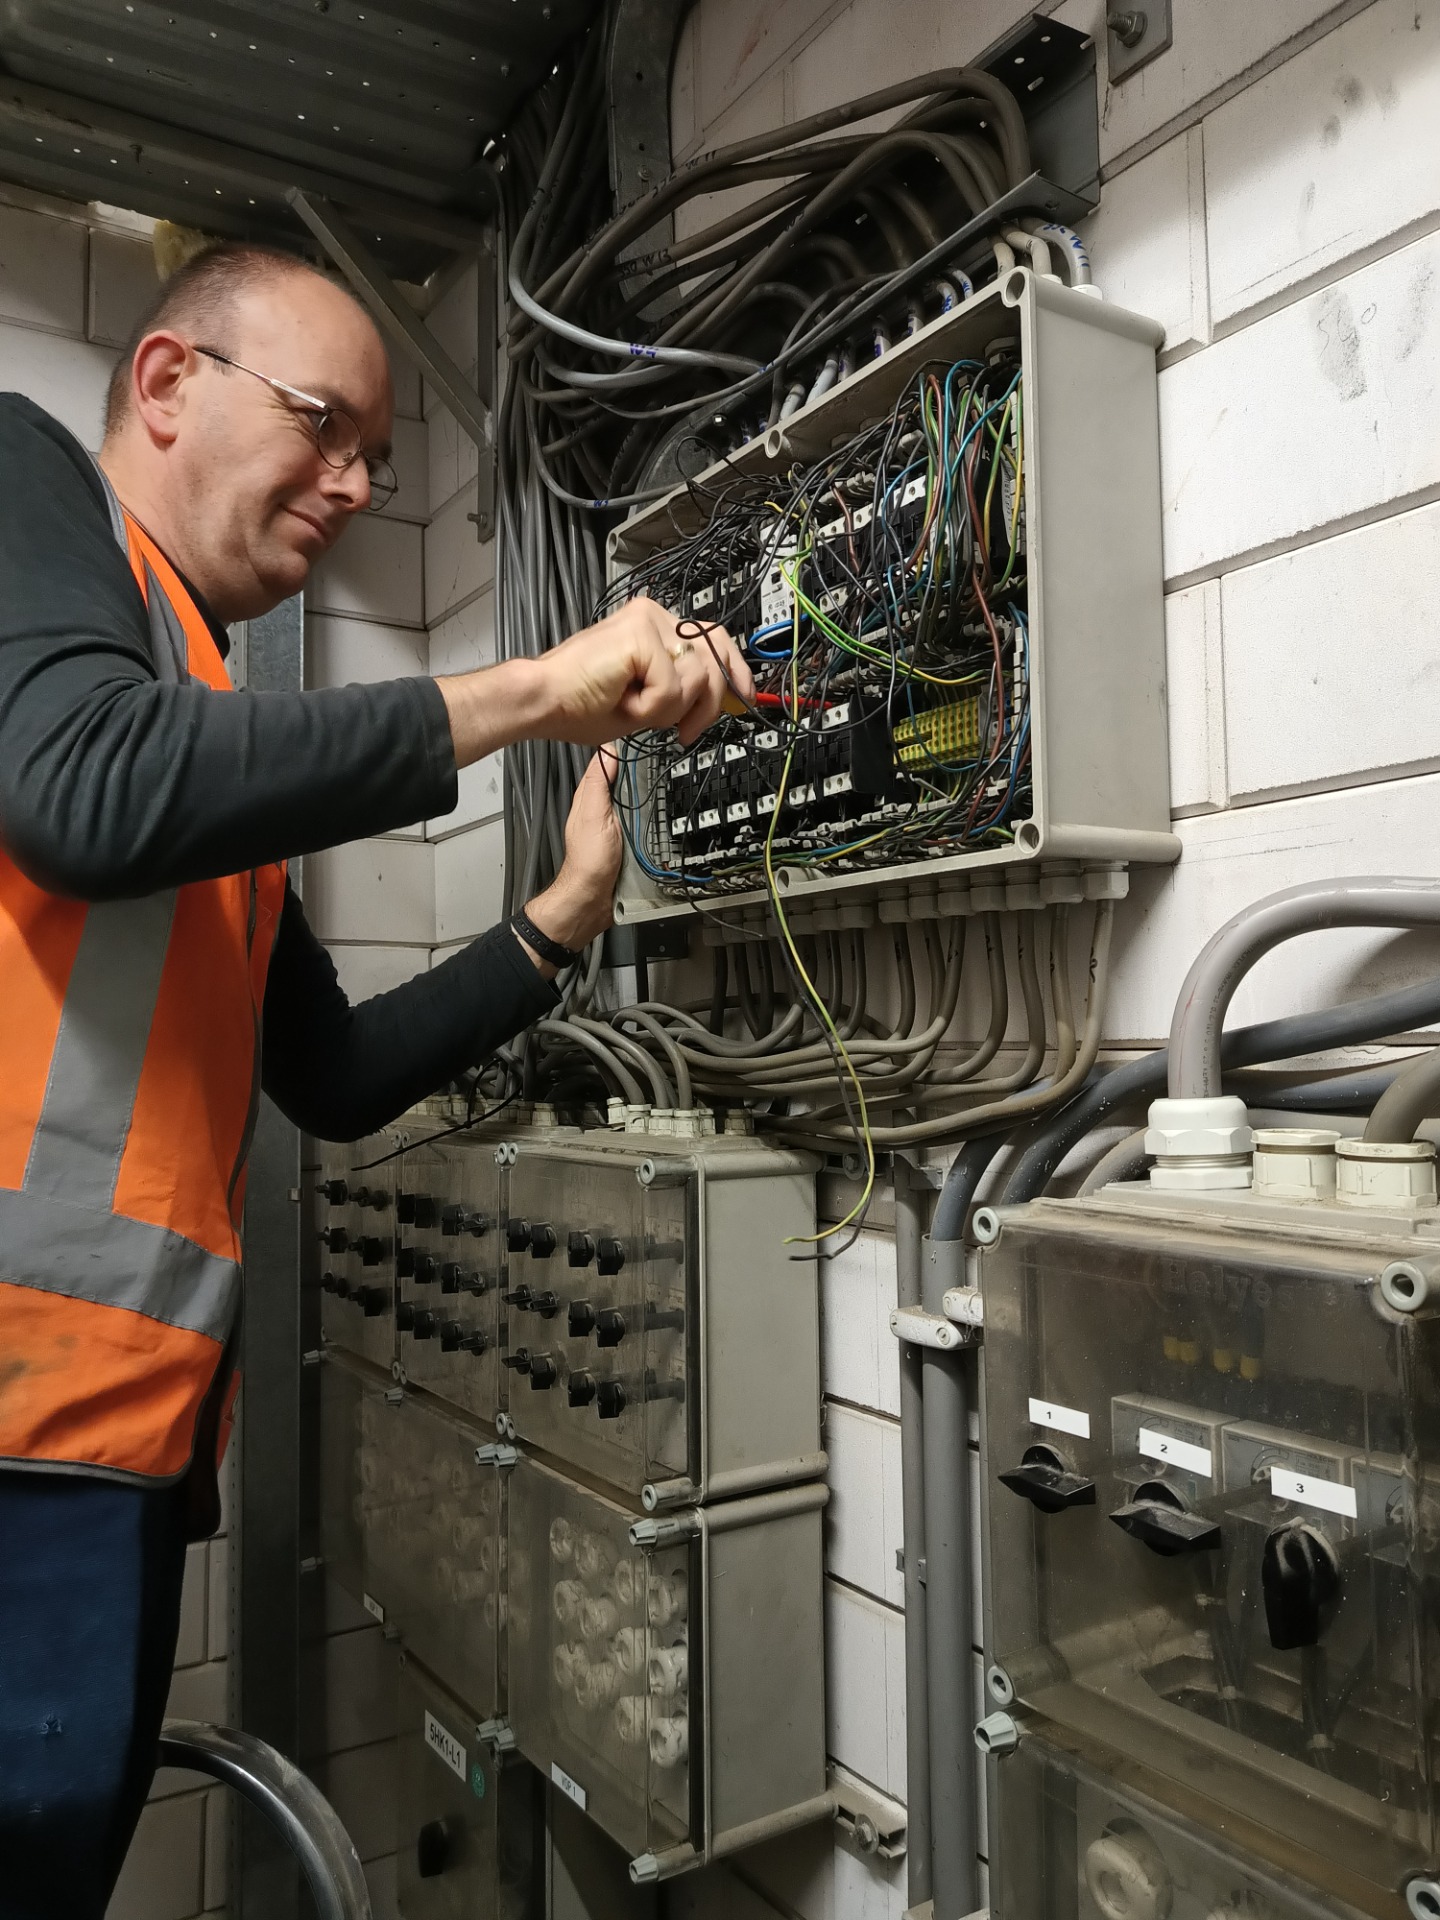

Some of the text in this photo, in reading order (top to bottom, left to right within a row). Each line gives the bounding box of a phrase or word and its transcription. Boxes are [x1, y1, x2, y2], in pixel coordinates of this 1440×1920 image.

[1045, 1411, 1053, 1420] 1
[1160, 1443, 1168, 1454] 2
[1295, 1482, 1305, 1494] 3
[429, 1722, 462, 1769] 5HK1-L1
